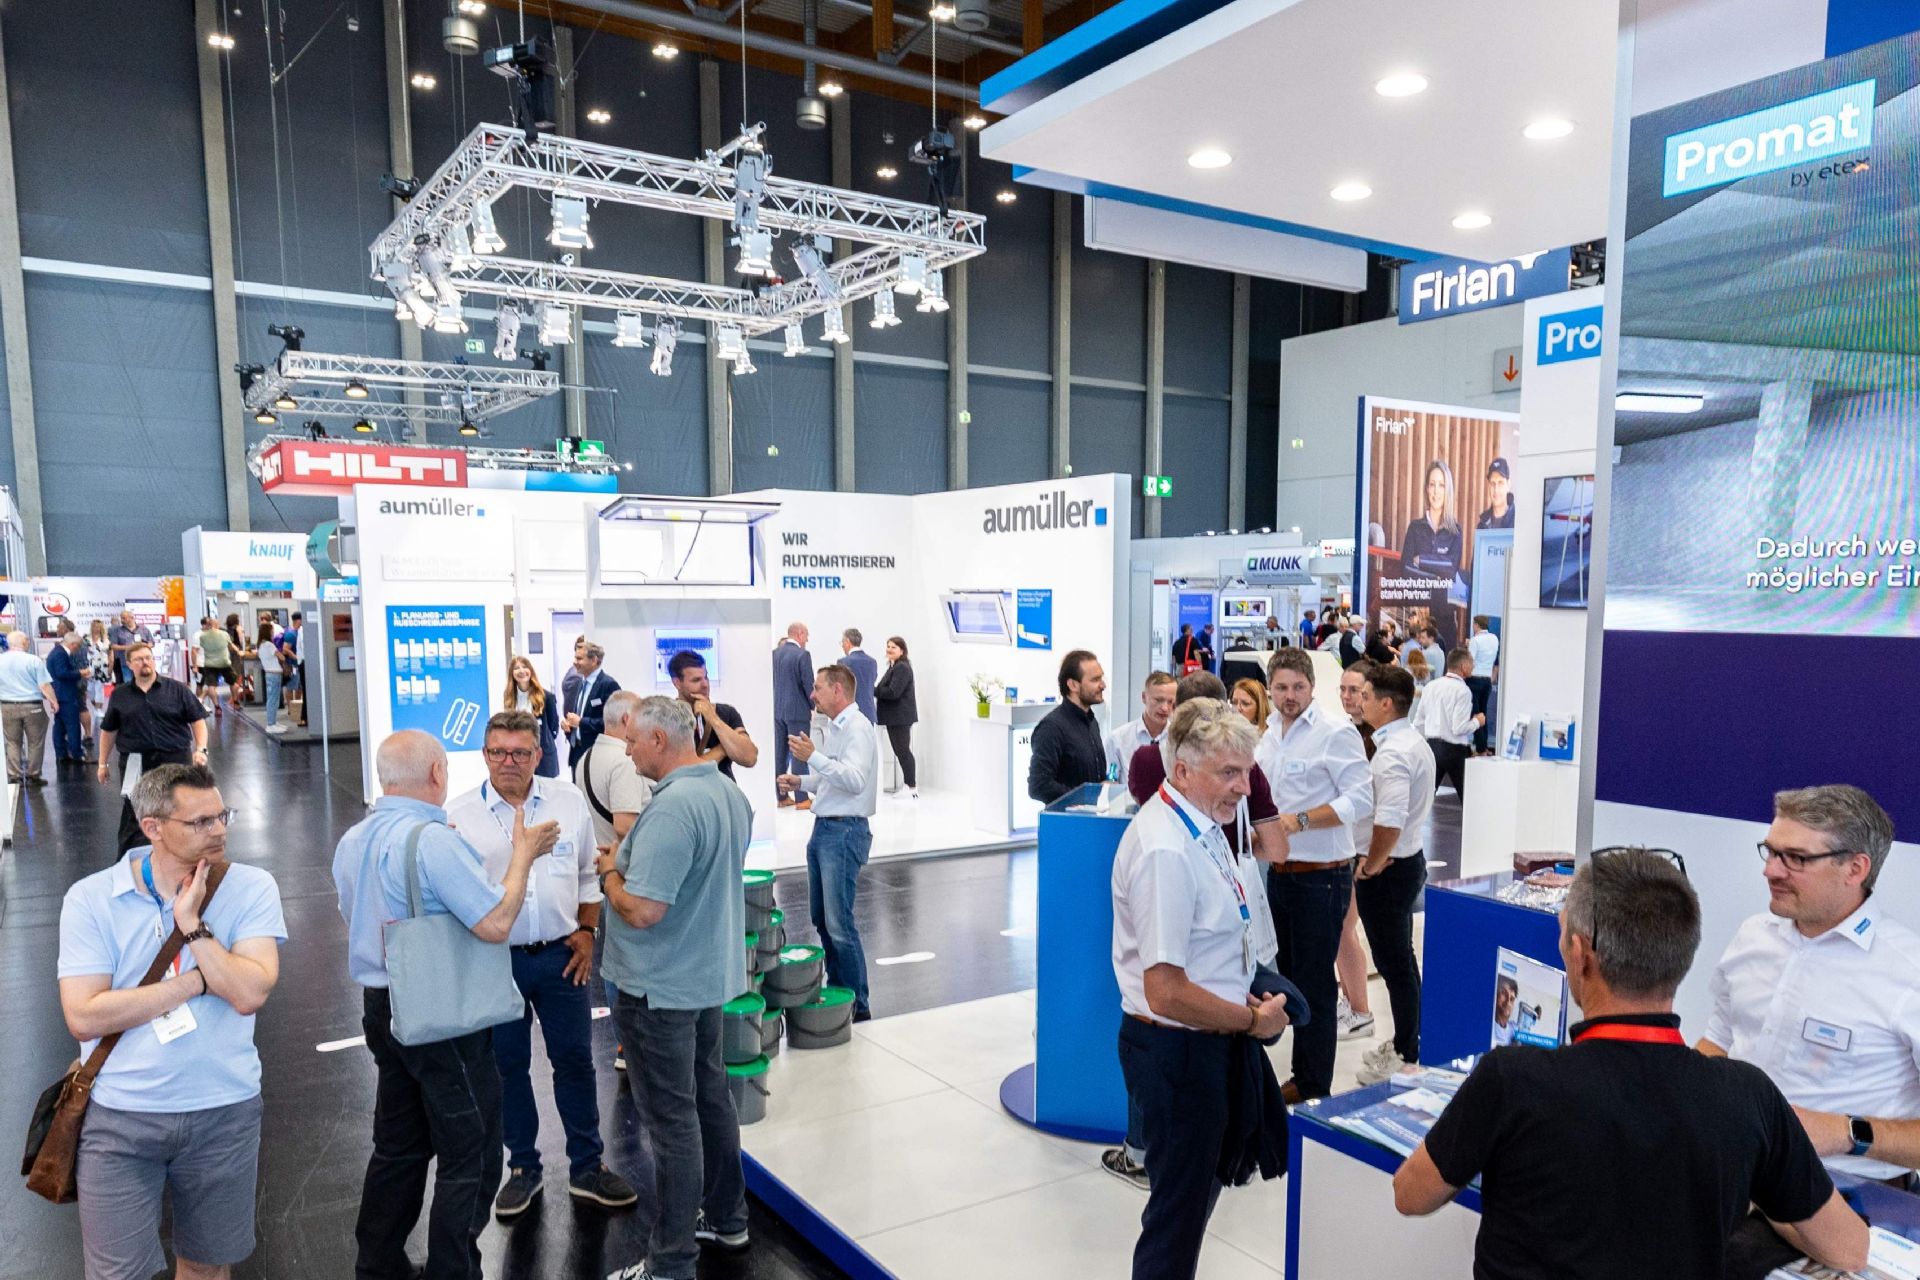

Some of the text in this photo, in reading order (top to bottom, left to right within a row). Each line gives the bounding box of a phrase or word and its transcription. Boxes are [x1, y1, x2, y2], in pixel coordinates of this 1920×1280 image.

[1677, 101, 1860, 182] Promat
[1791, 169, 1813, 188] by
[1412, 263, 1515, 315] Firian
[1546, 321, 1601, 356] Pro
[1375, 416, 1407, 436] Firian
[294, 450, 457, 482] HILTI
[379, 497, 474, 517] aumüller
[984, 490, 1093, 533] aumüller
[782, 532, 808, 545] WIR
[1756, 534, 1920, 559] Dadurch we
[782, 554, 896, 568] AUTOMATISIEREN
[1259, 555, 1303, 571] MUNK
[782, 576, 845, 589] FENSTER.
[1380, 576, 1425, 589] Brandschutz
[1746, 564, 1879, 594] möglicher
